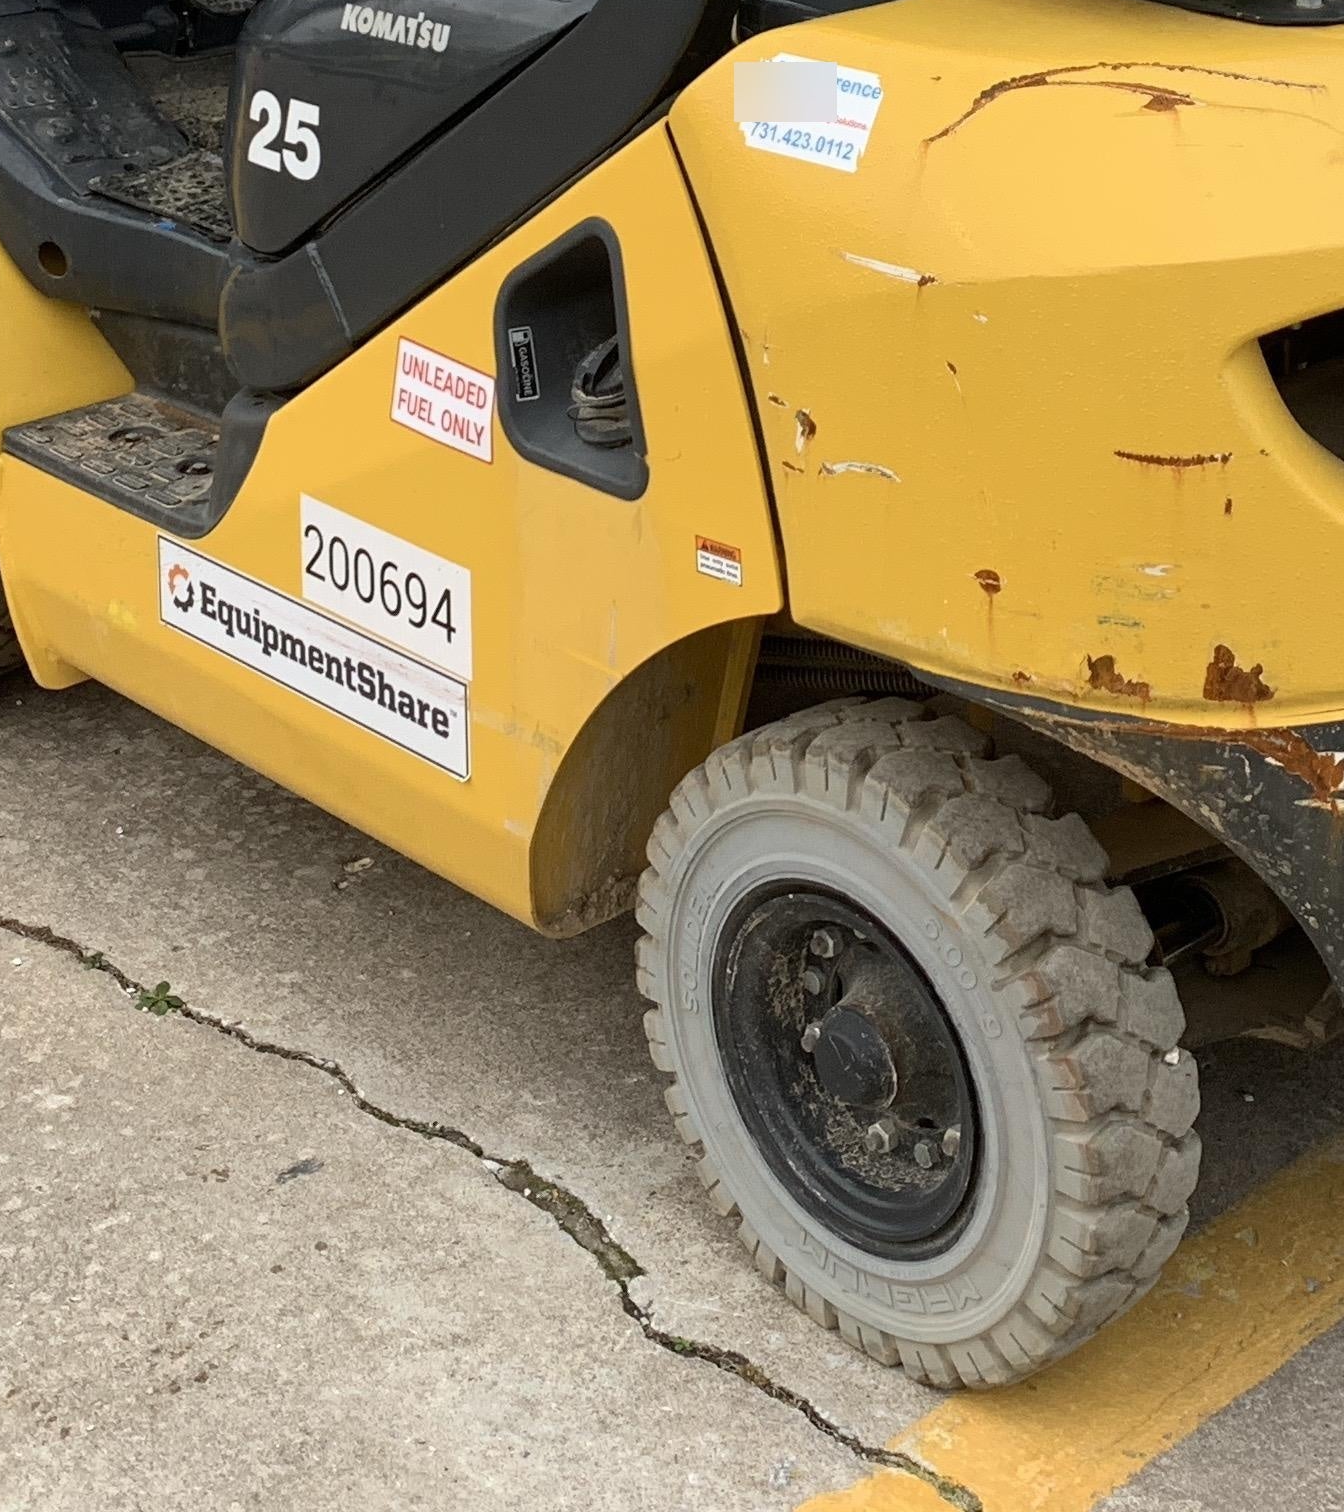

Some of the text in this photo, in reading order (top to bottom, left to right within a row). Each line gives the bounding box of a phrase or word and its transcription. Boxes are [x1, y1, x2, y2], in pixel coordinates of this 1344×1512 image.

[340, 3, 452, 53] KOMATSU
[836, 76, 882, 100] rence
[248, 89, 321, 180] 25
[750, 122, 855, 160] 731.423.0112
[402, 352, 487, 410] UNLEADED
[398, 388, 485, 446] FUEL ONLY
[304, 524, 457, 644] 200694
[199, 580, 450, 739] EquipmentShare
